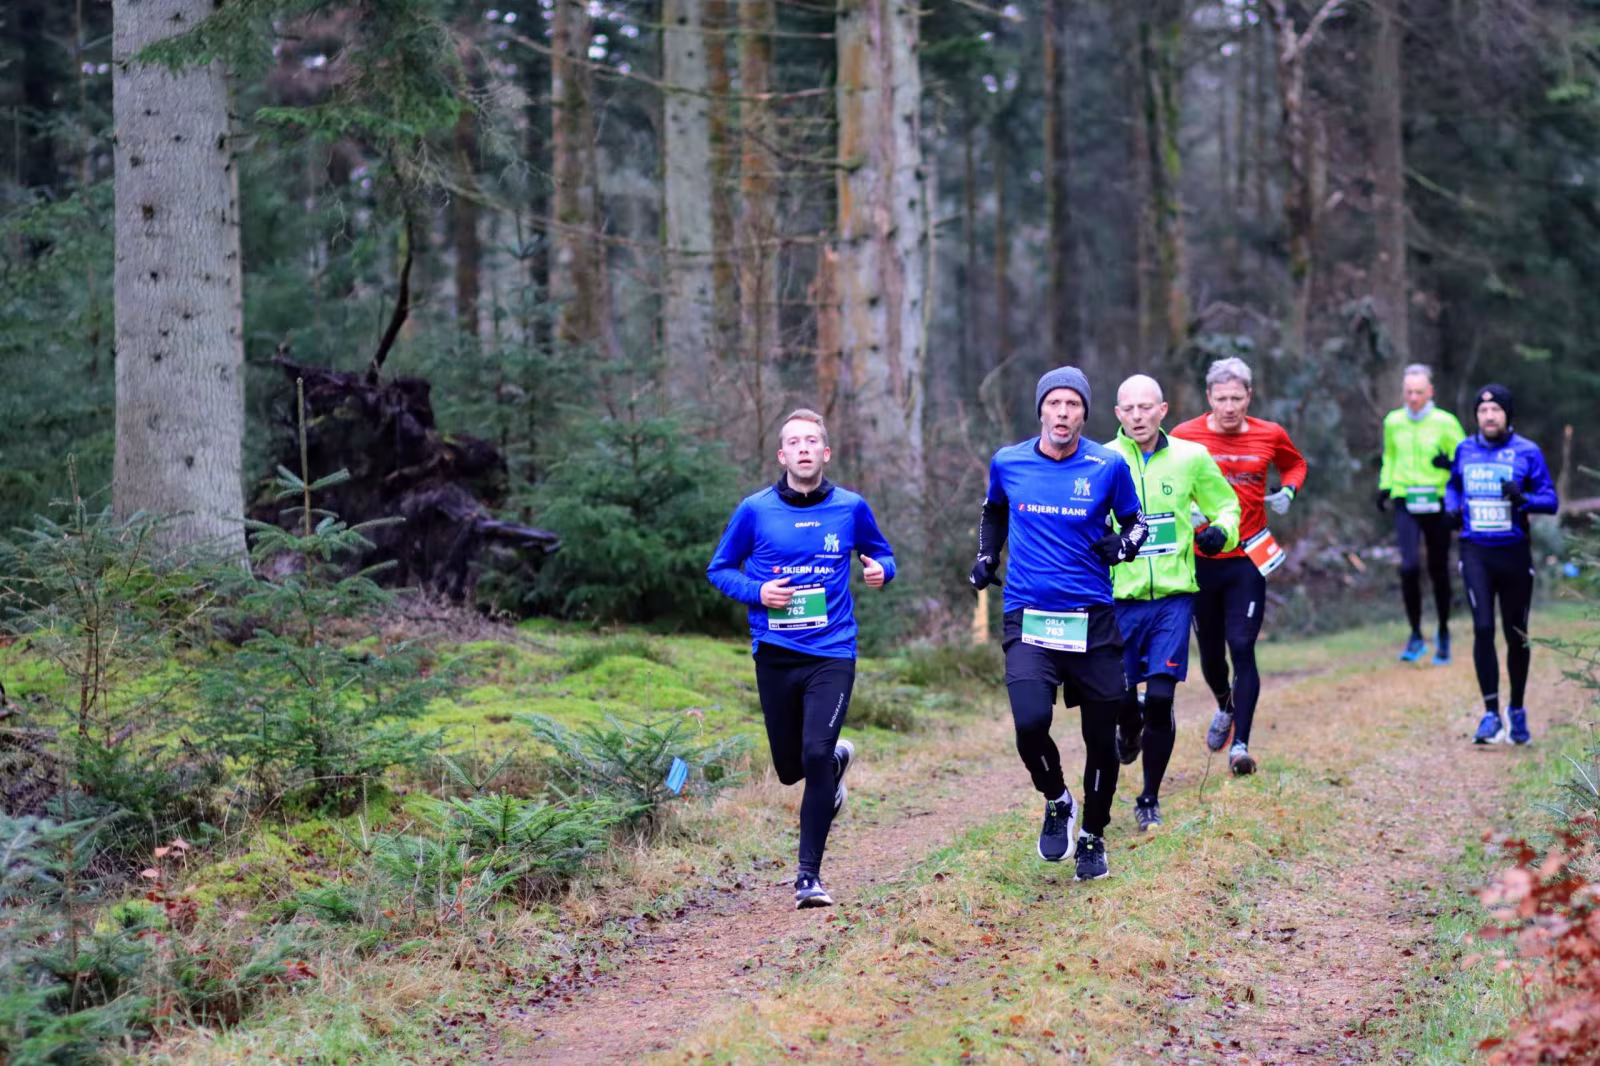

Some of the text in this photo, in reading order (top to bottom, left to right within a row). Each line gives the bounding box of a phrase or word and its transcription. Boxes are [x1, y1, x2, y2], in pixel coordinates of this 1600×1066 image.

[1027, 504, 1087, 516] SKJERN BANK
[1474, 507, 1506, 521] 1103
[782, 566, 812, 574] SKJERN
[786, 606, 805, 616] 762
[1045, 618, 1066, 626] ORLA
[1045, 627, 1064, 636] 763
[828, 692, 844, 728] ENDURANCE
